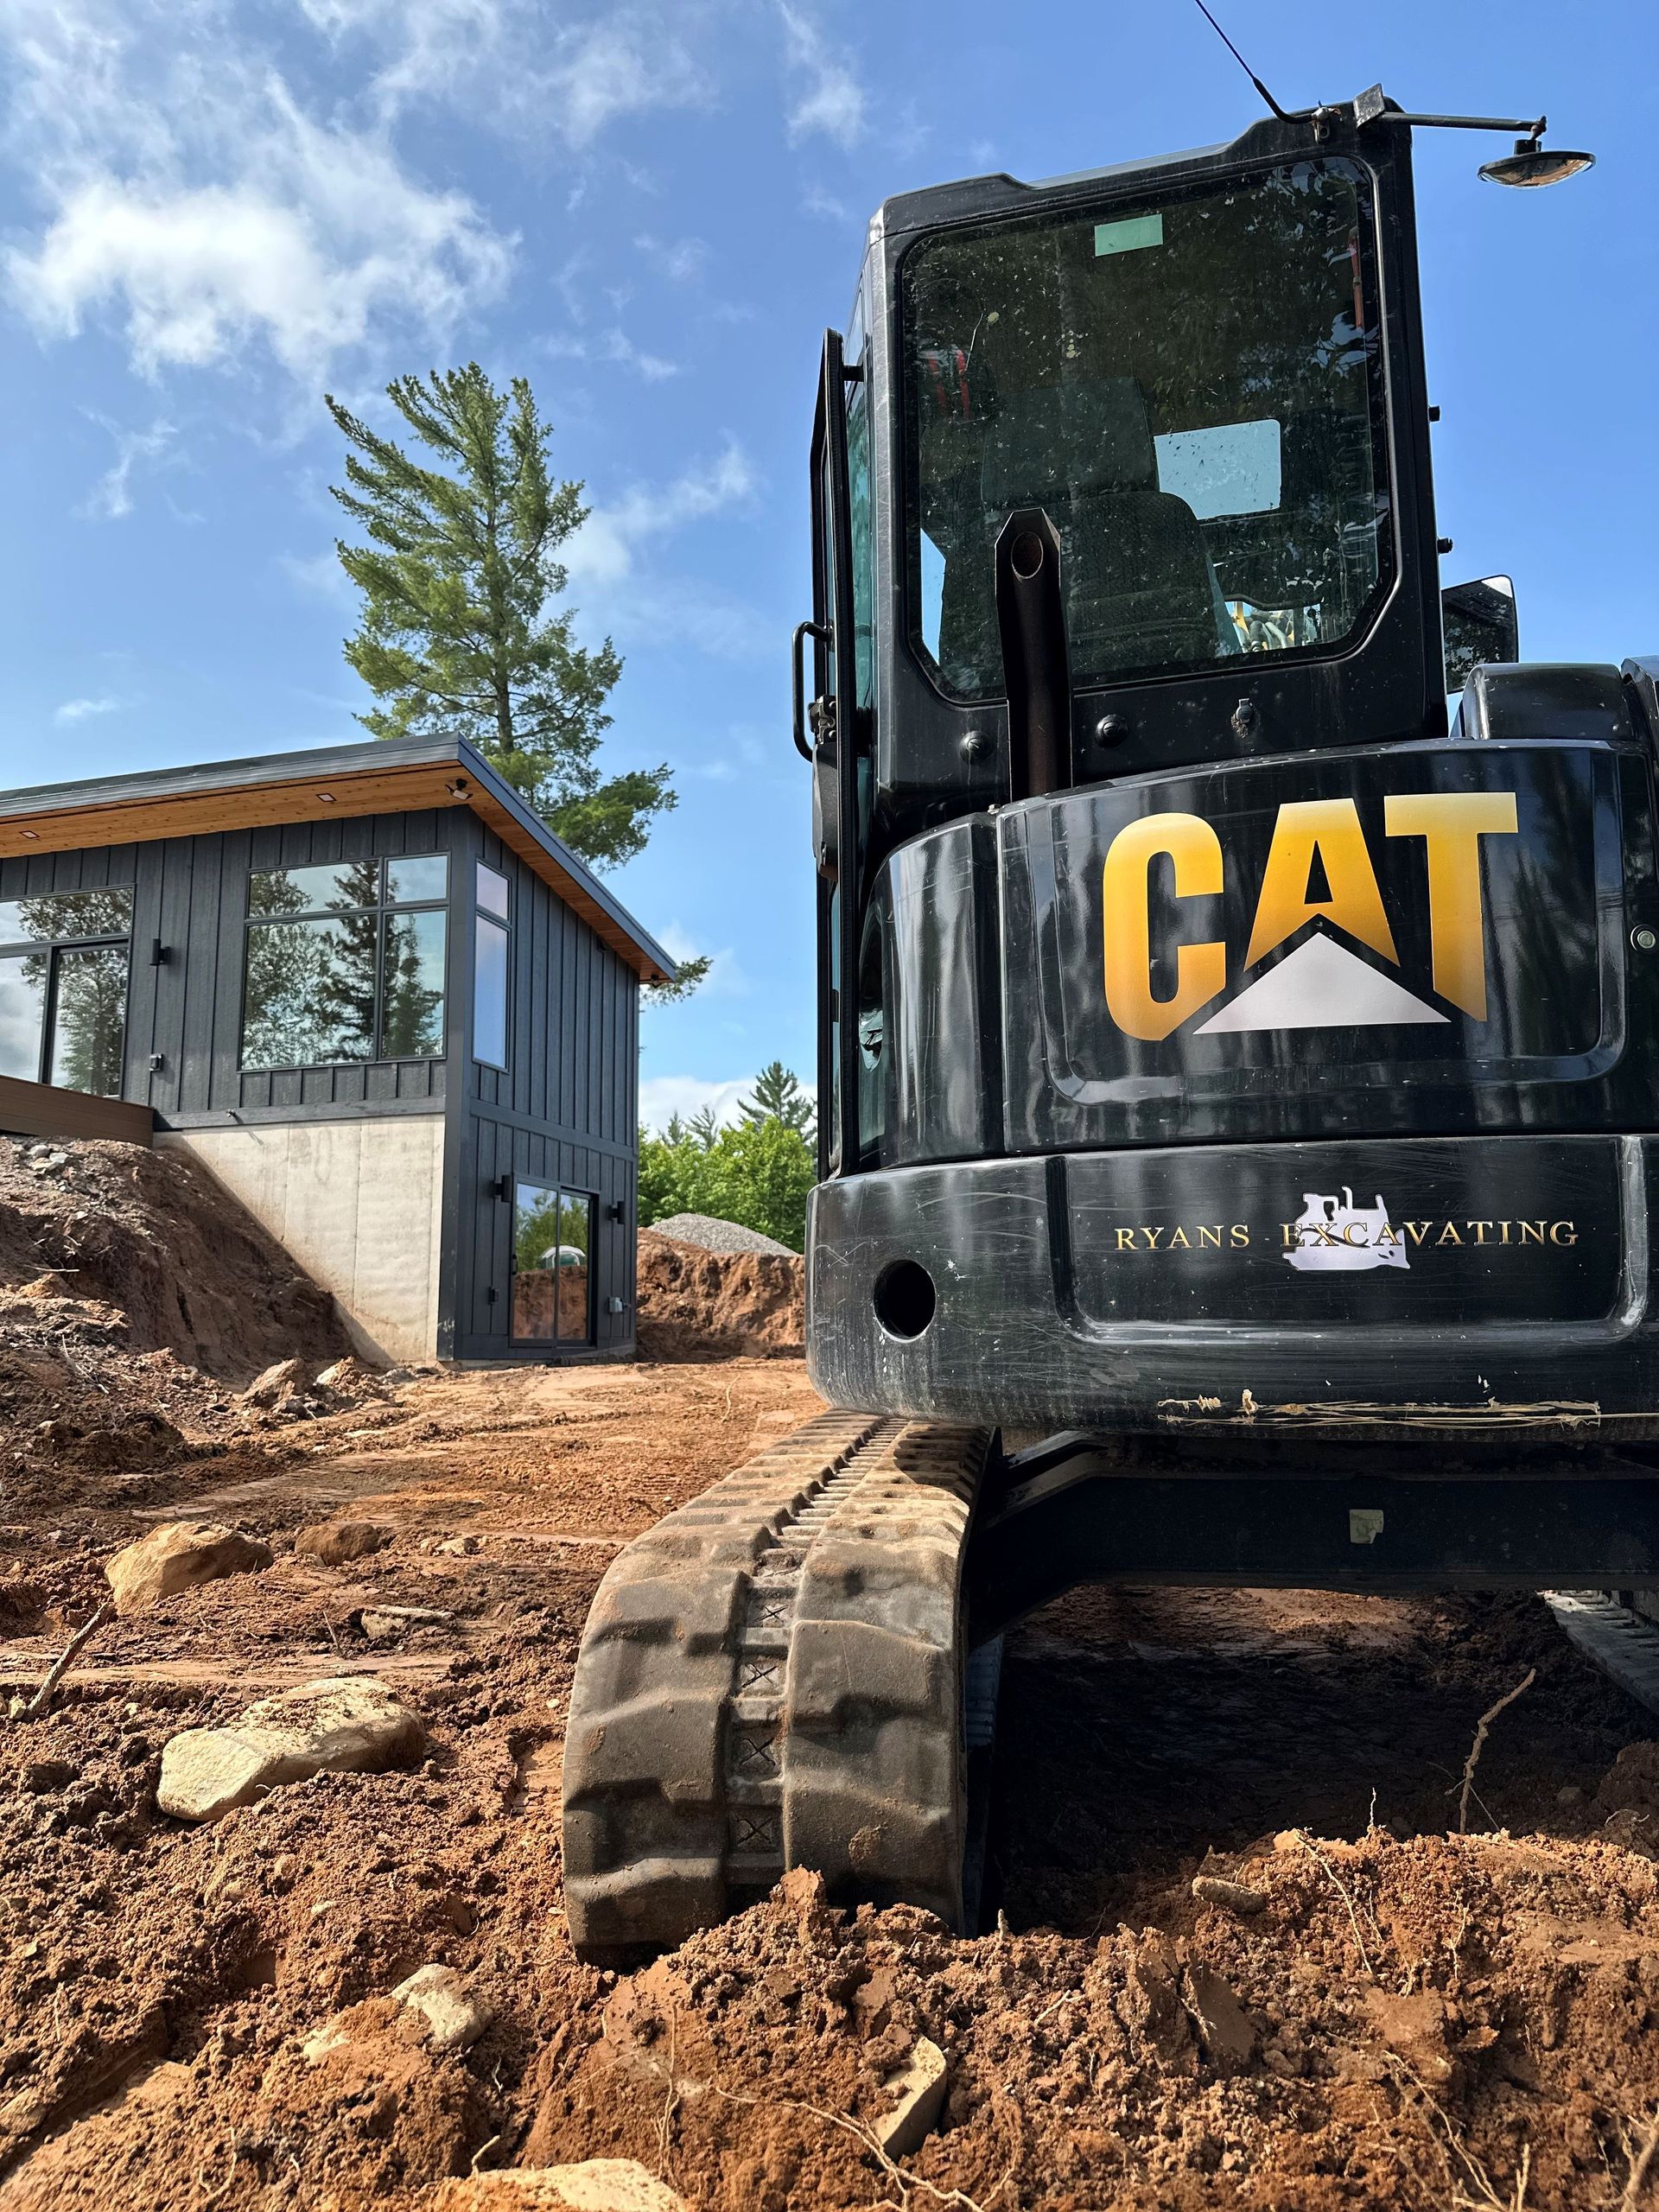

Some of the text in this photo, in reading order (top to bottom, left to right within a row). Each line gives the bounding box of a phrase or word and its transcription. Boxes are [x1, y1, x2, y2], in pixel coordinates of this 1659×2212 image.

[1103, 791, 1518, 1041] CAT
[1114, 1220, 1579, 1250] RYANS EXCAVATING
